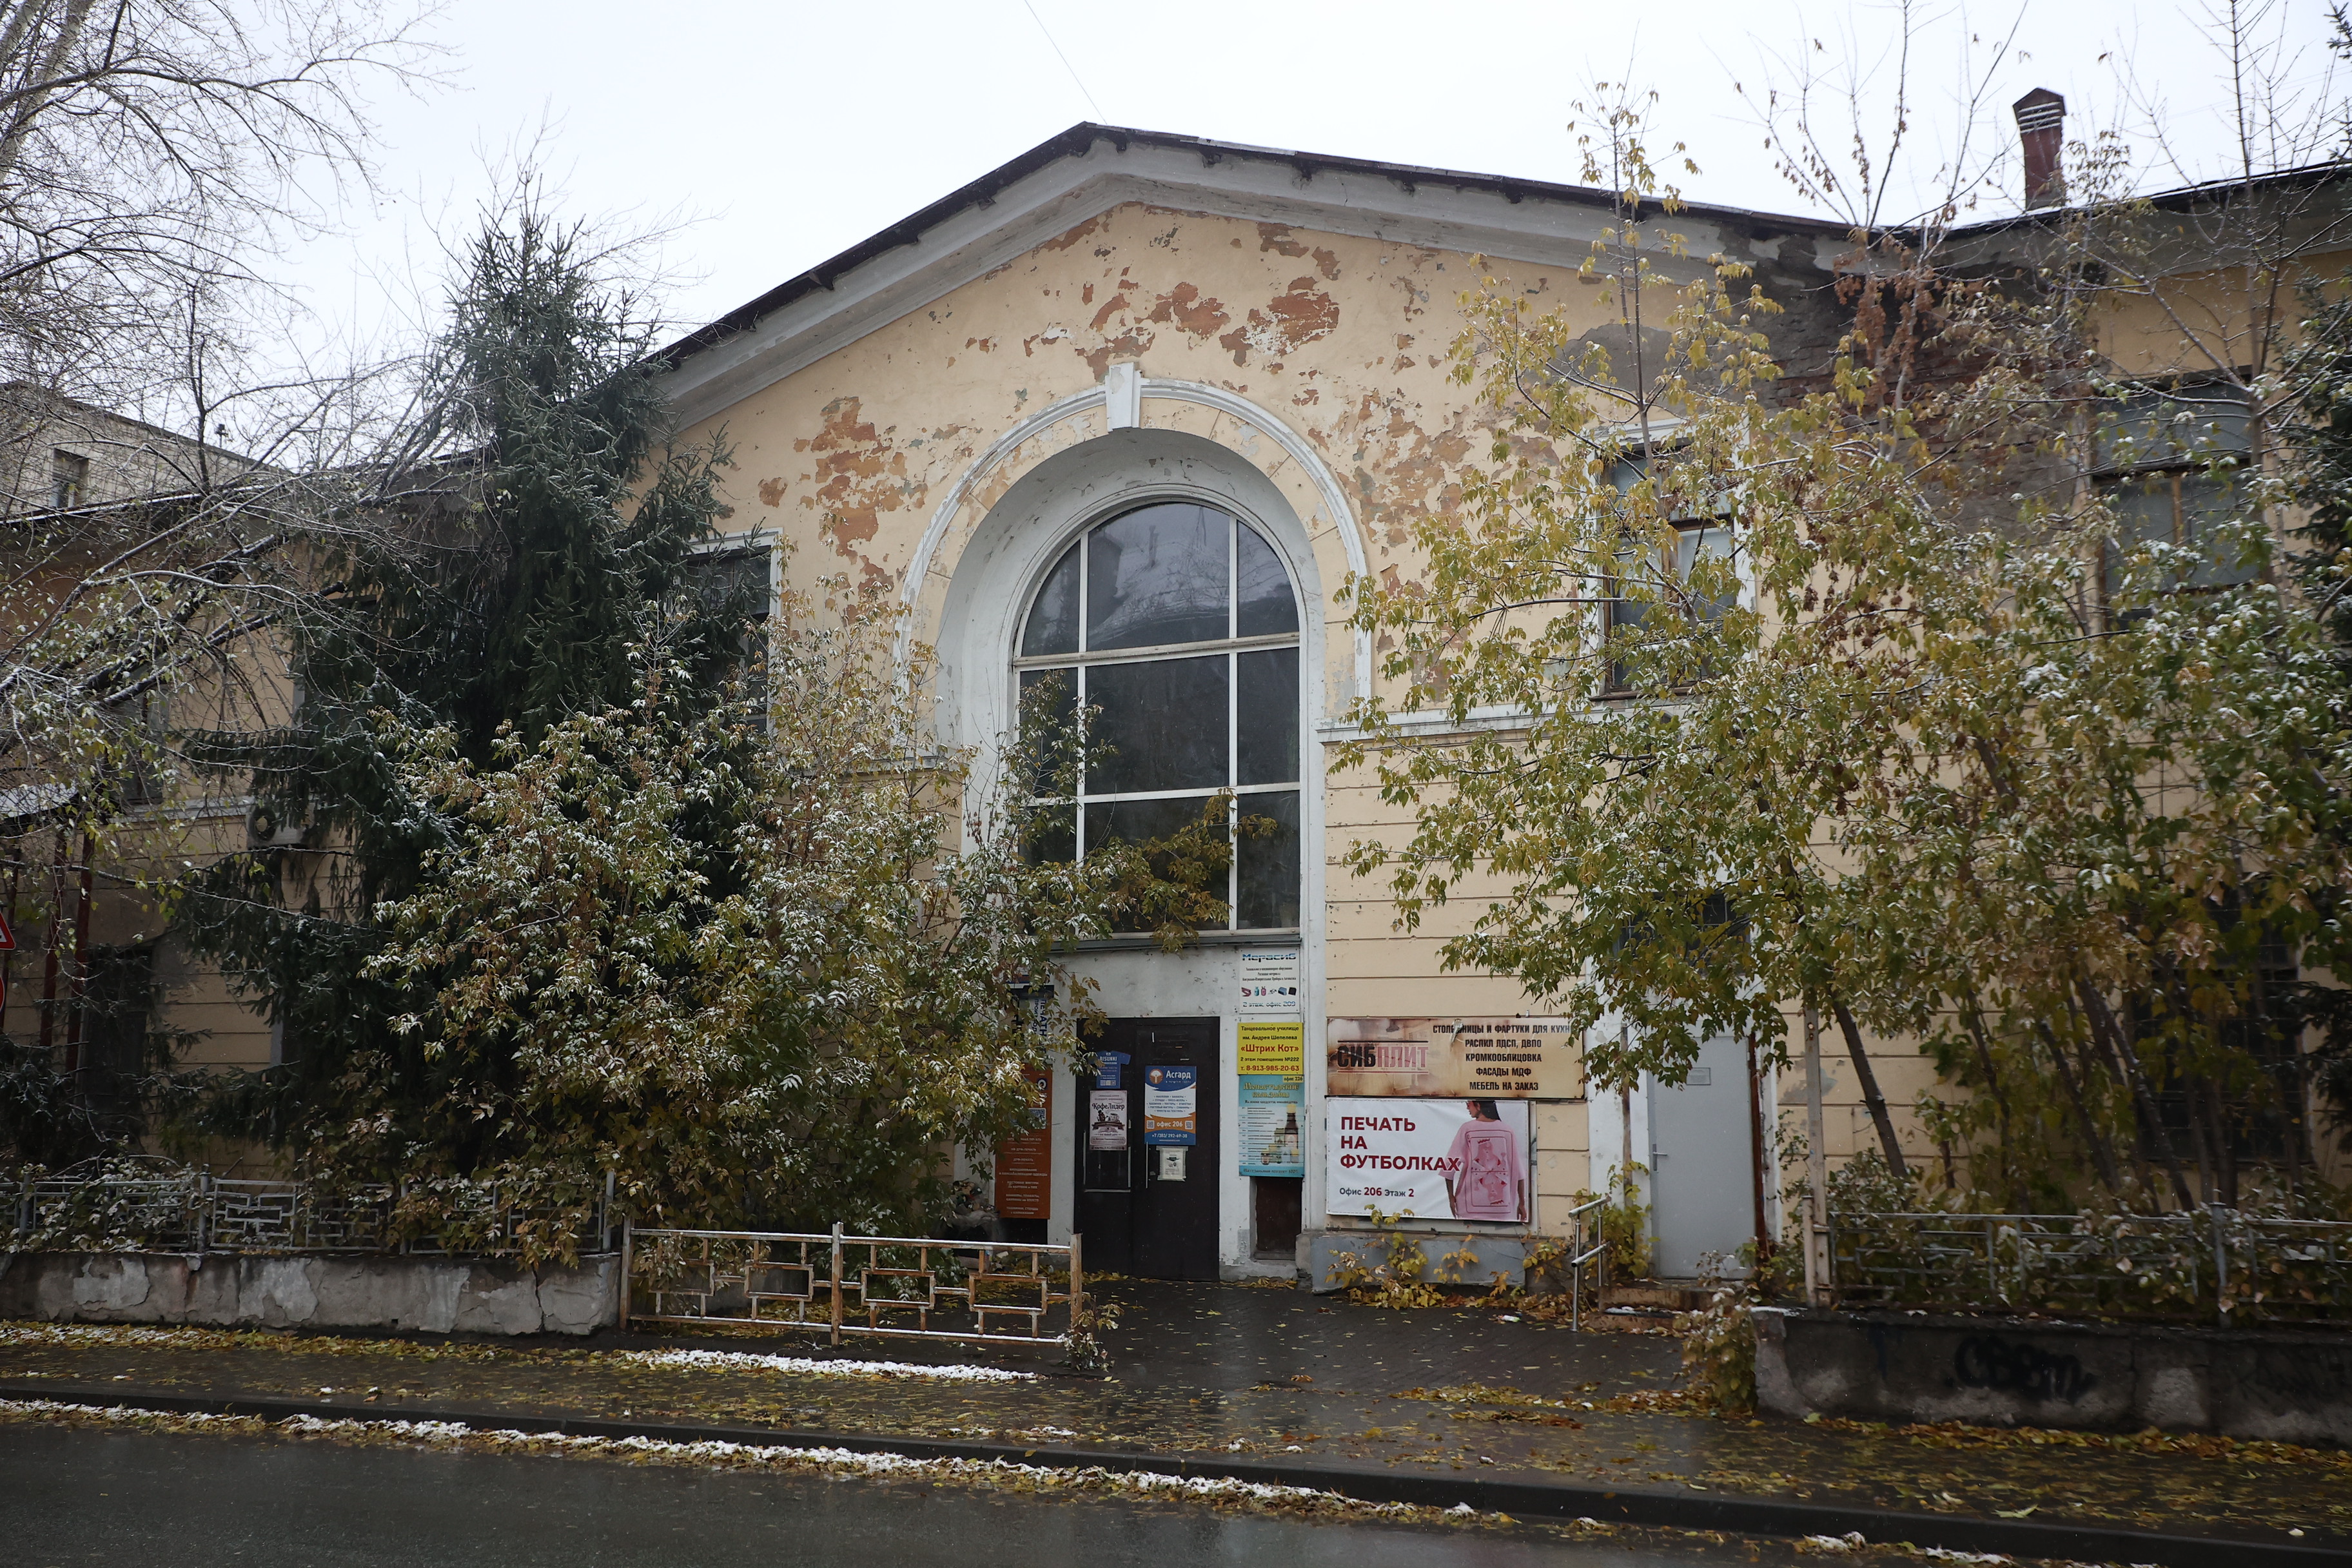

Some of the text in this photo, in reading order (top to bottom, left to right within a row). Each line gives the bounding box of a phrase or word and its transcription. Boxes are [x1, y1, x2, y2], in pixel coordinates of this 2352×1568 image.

[1433, 1024, 1571, 1034] СТОЛЕНИЦЫ И ФАРТУКИ ДЛЯ КУХН
[1496, 1039, 1518, 1048] ЛДСП,
[1521, 1039, 1542, 1048] ДВПО
[1240, 1044, 1299, 1054] «Штрих Кот»
[1337, 1045, 1429, 1068] СИБПЛИТ
[1465, 1053, 1542, 1063] КРОМКООБЛИЦОВКА
[1166, 1070, 1191, 1080] Асгард
[1476, 1067, 1531, 1077] ФАСАДЫ МДФ
[1469, 1082, 1539, 1091] МЕБЕЛЬ НА ЗАКАЗ
[1092, 1102, 1125, 1111] КофеЛидер
[1340, 1116, 1416, 1132] ПЕЧАТЬ
[1340, 1135, 1368, 1150] НА
[1340, 1153, 1460, 1172] ФУТБОЛКАХ
[1339, 1186, 1415, 1197] Офис 206 Этаж 2
